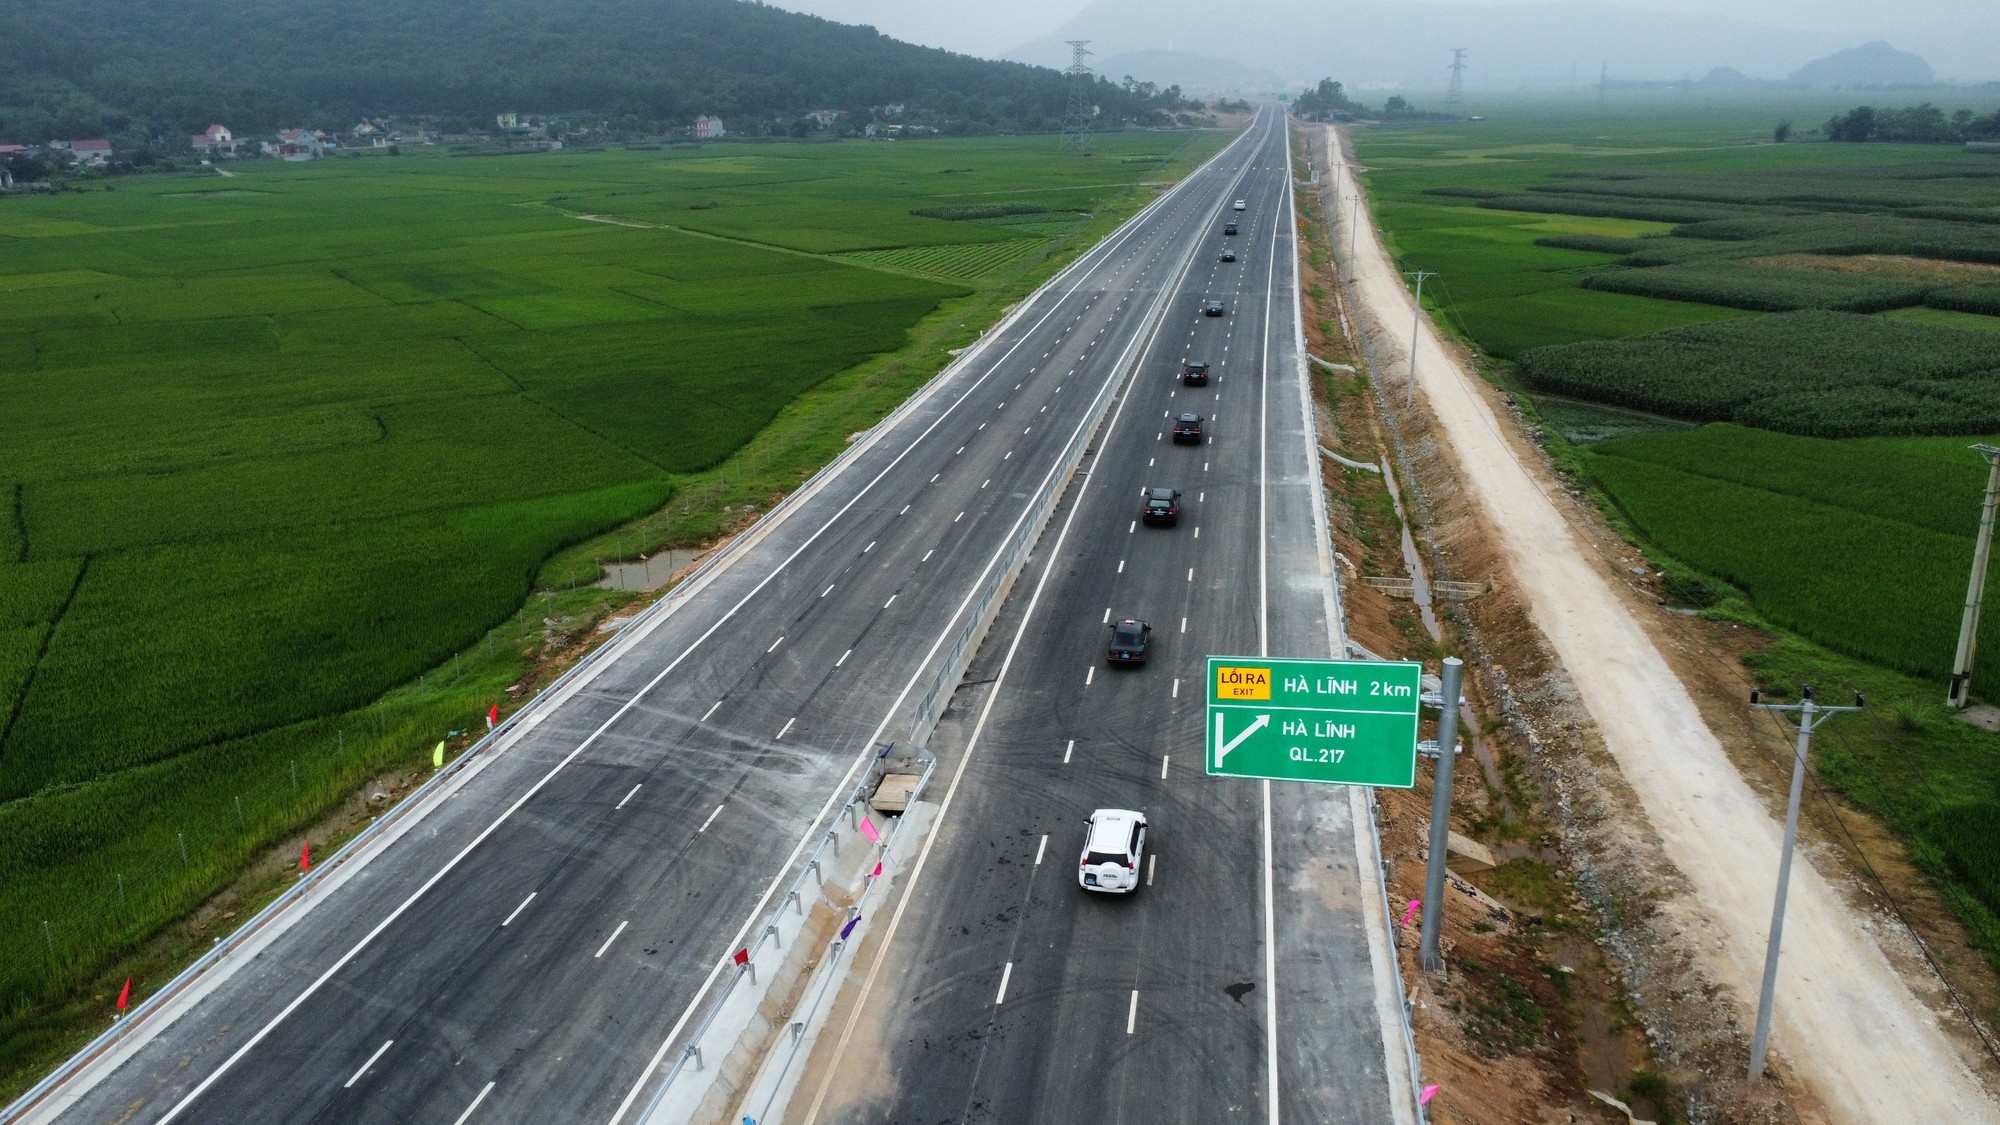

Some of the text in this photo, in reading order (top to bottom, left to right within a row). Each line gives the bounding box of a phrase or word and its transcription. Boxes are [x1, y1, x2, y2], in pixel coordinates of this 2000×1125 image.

[1221, 668, 1266, 685] LỐI RA
[1284, 675, 1309, 693] HÀ
[1317, 677, 1357, 695] LĨNH
[1233, 687, 1254, 696] EXIT
[1283, 718, 1355, 739] HÀ LĨNH
[1289, 747, 1345, 764] QL.217
